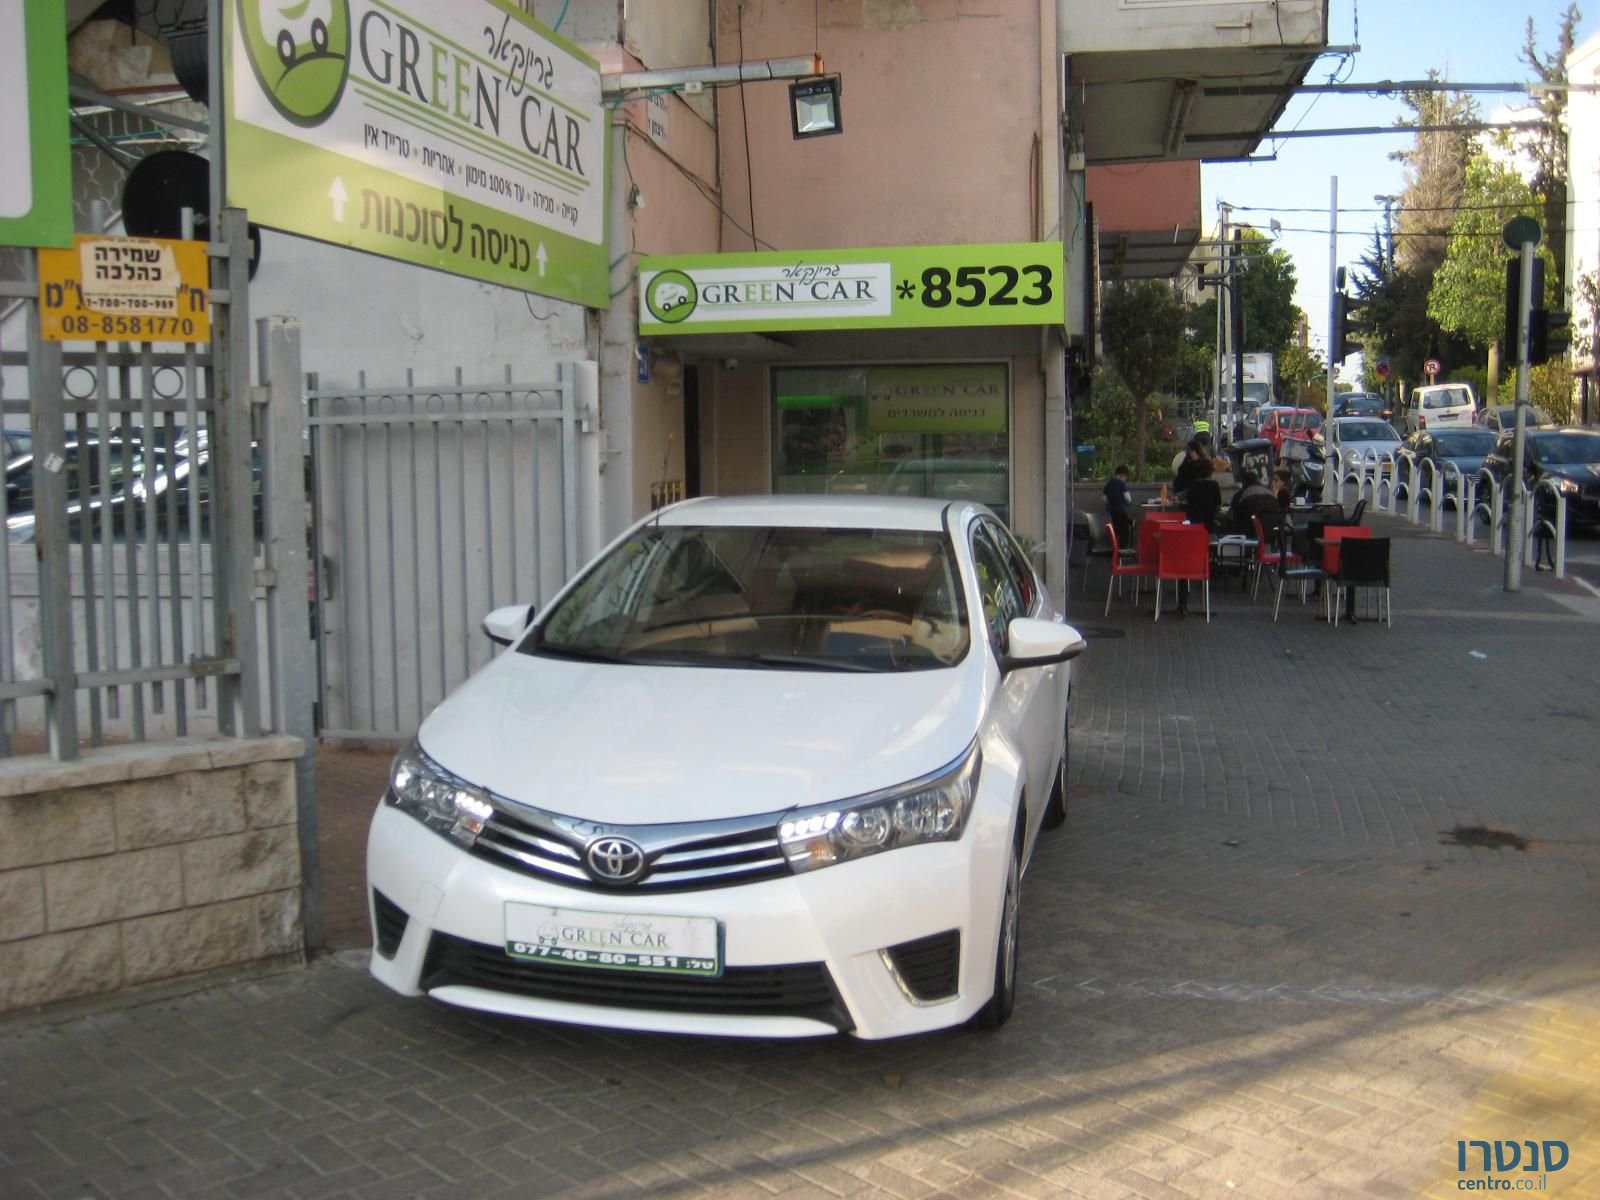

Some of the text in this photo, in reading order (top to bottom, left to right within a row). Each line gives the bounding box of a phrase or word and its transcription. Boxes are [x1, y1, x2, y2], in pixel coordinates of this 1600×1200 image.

[359, 10, 585, 176] GREEN CAR
[364, 123, 379, 150] אין
[381, 130, 410, 159] טרייד
[422, 146, 455, 177] אחריות
[465, 164, 487, 188] מימון
[489, 174, 512, 198] 100%
[513, 182, 525, 203] עד
[360, 188, 531, 272] כניסה לסוכנות
[95, 246, 161, 263] שמירה
[96, 264, 162, 281] כהלכה
[702, 280, 873, 304] GREEN CAR
[62, 315, 194, 336] 08-8581770
[963, 384, 999, 394] CAR
[561, 927, 668, 948] GREEN CAR
[513, 942, 679, 968] 077-40-80-551
